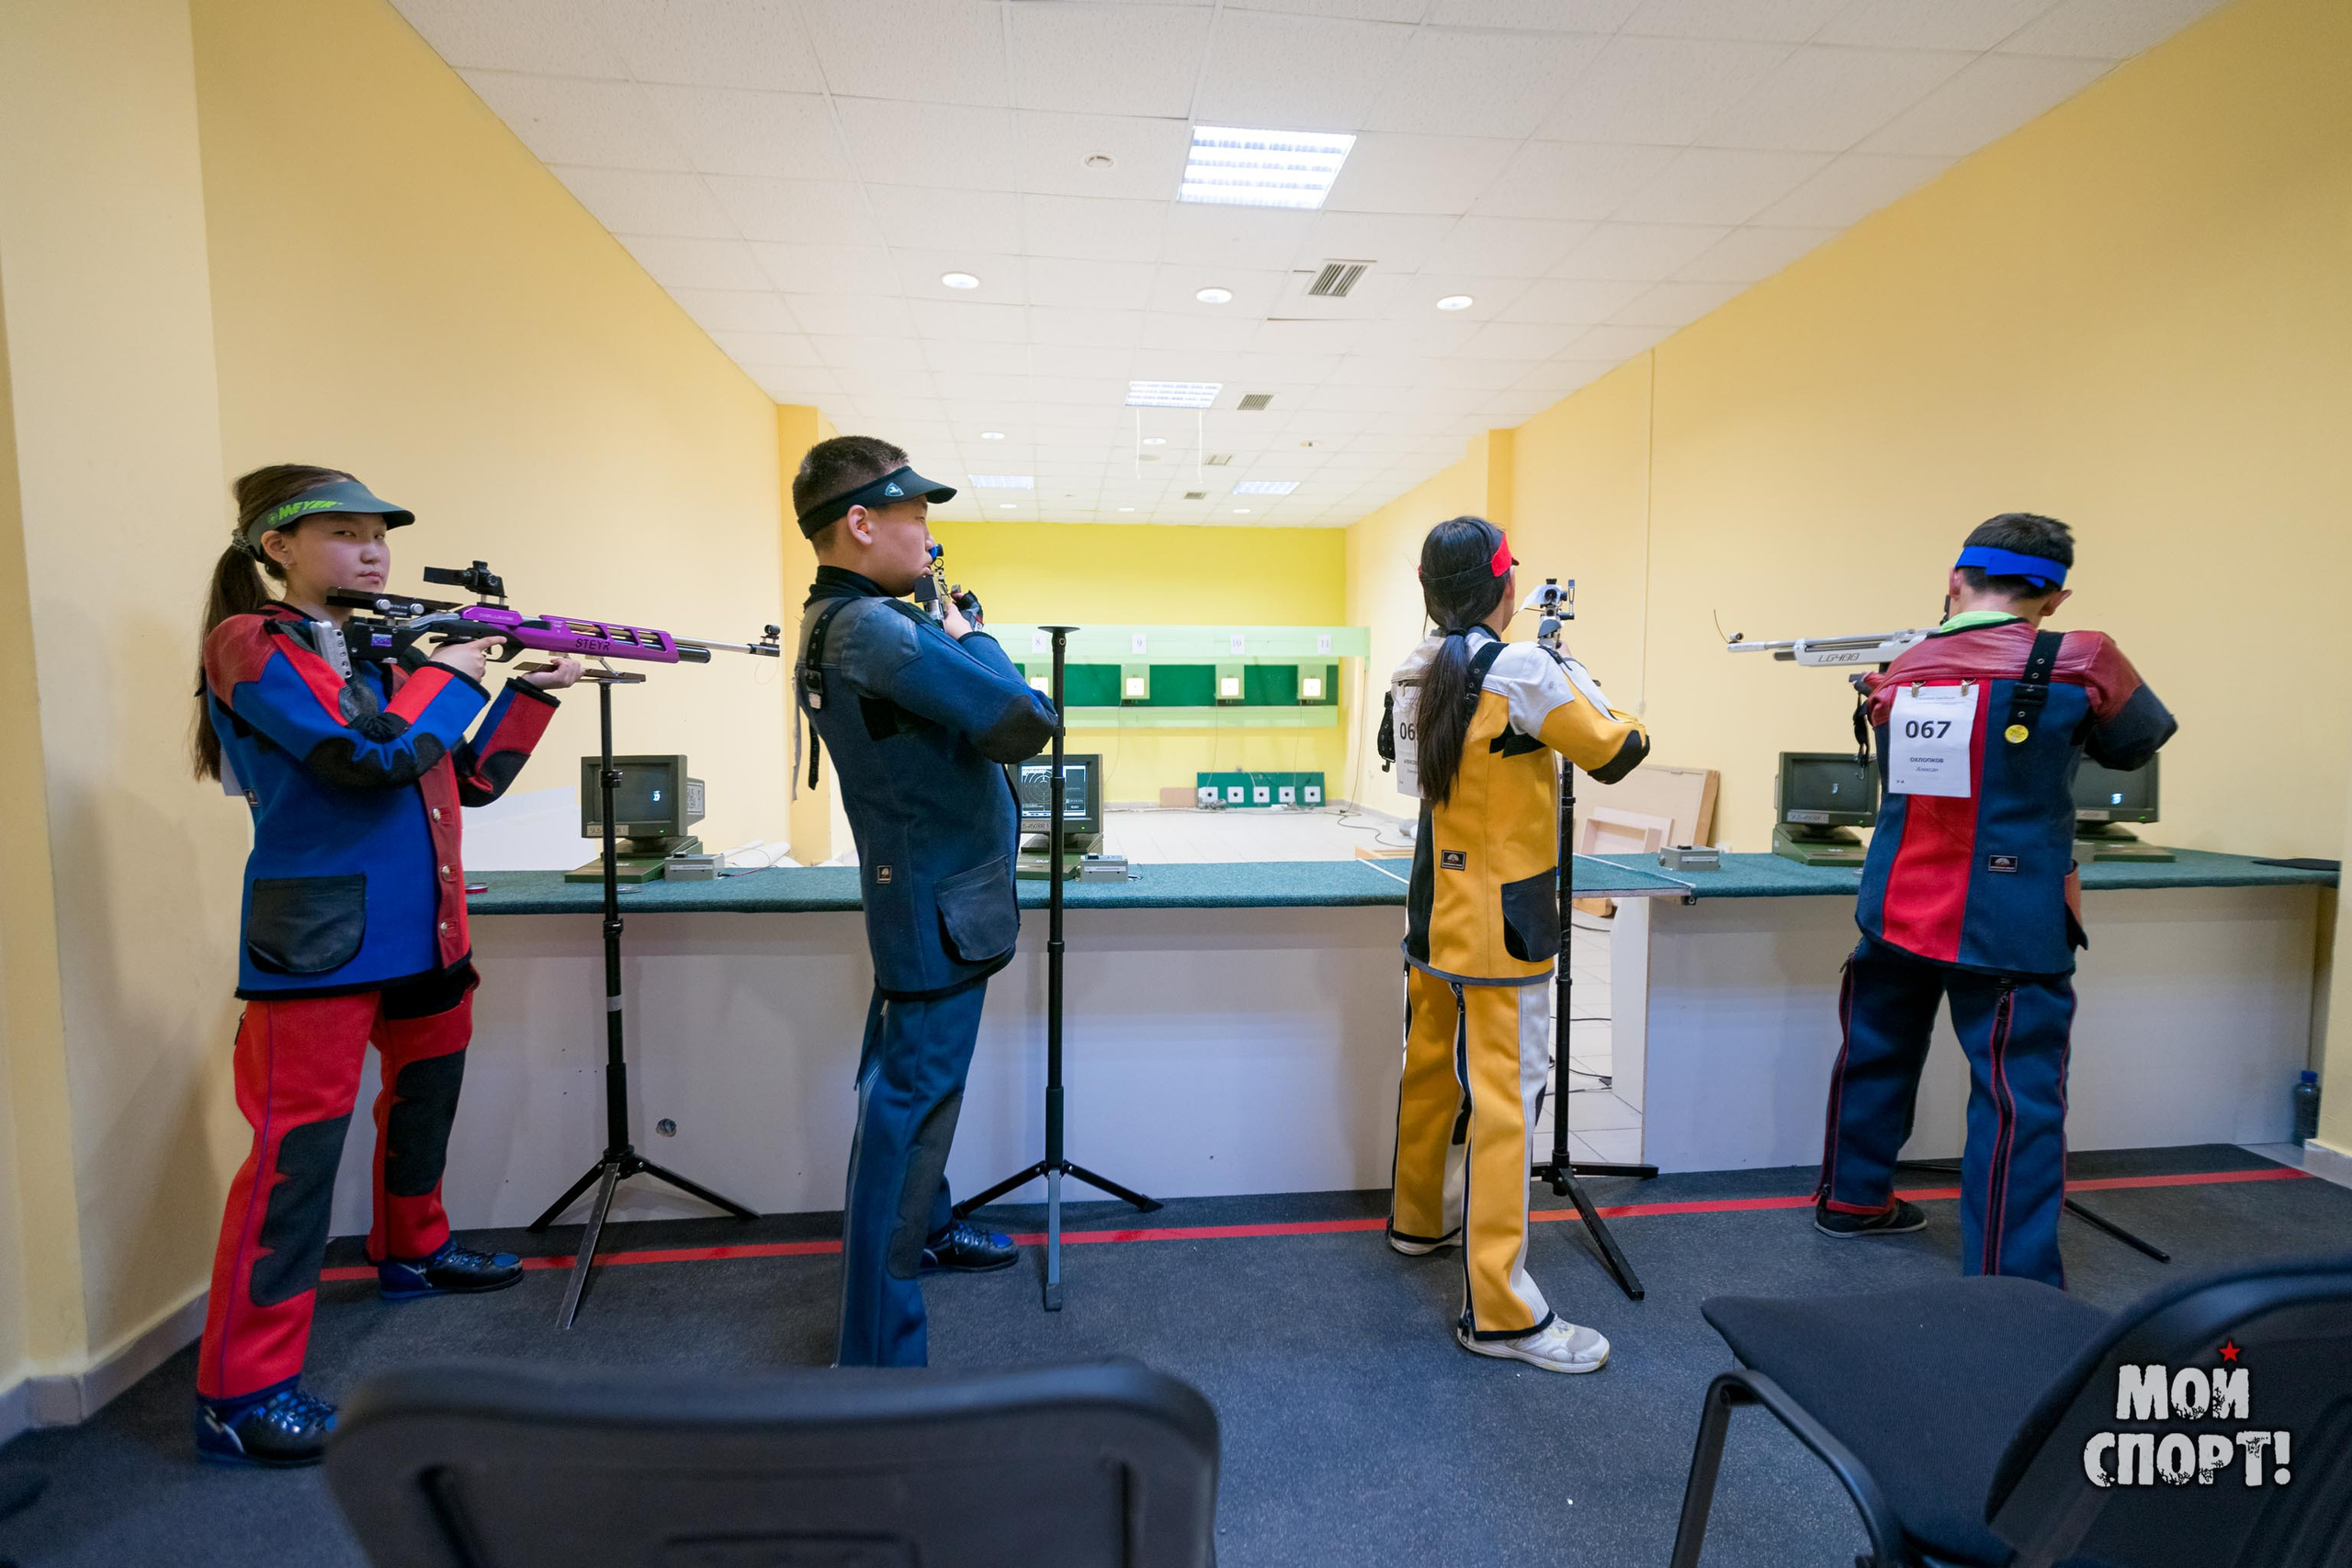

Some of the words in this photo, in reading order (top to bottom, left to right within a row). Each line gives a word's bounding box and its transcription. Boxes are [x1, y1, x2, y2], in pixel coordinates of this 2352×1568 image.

[575, 637, 611, 651] STEYR
[1232, 638, 1242, 648] 10
[1321, 639, 1329, 648] 11
[1818, 652, 1860, 662] LG400
[1399, 722, 1418, 741] 06
[1905, 720, 1952, 739] 067
